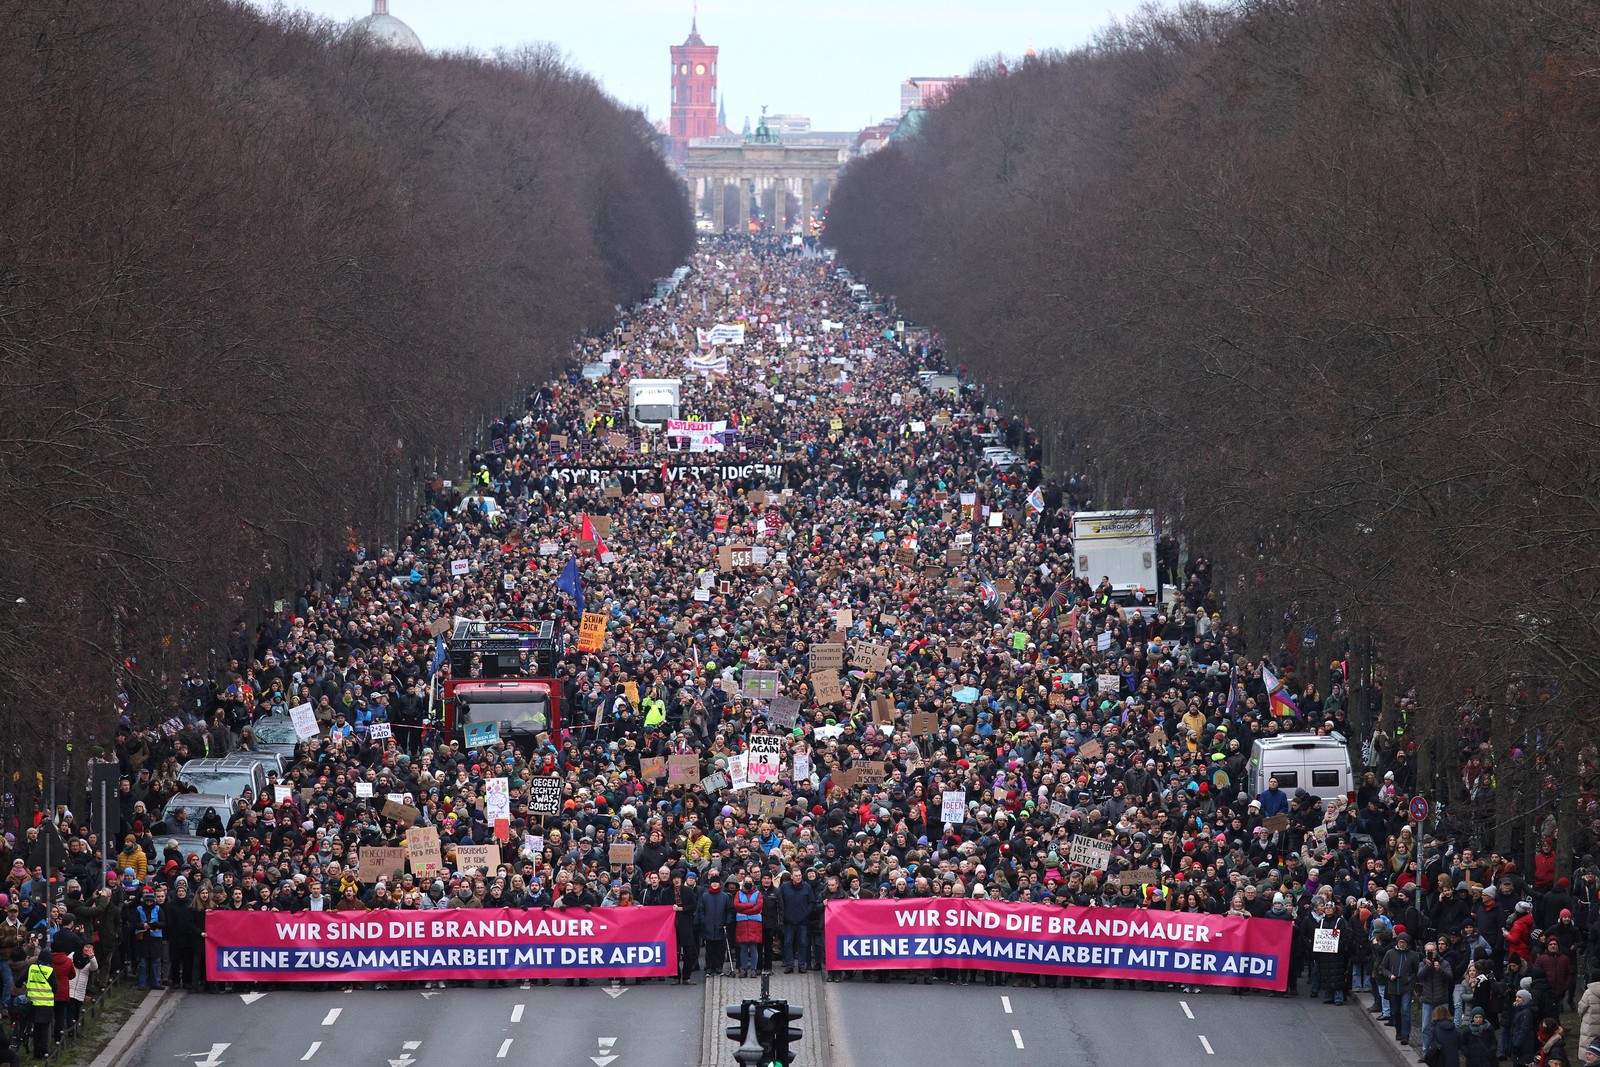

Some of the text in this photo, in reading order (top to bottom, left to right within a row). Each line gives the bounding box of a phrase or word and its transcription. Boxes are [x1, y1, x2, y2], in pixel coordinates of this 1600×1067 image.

[668, 420, 714, 430] ASYLRECHT
[732, 551, 750, 560] FCK
[858, 644, 878, 656] FCK
[854, 654, 872, 665] AFD
[820, 686, 840, 697] MERZ
[751, 736, 779, 746] NEVER
[750, 744, 779, 754] AGAIN
[760, 754, 768, 764] IS
[750, 762, 778, 776] NOW
[532, 778, 559, 787] GEGEN
[530, 787, 560, 798] RECHTS!
[944, 802, 964, 810] IDEEN
[944, 813, 962, 822] MERZ
[1074, 836, 1112, 852] NIE WIEDER
[425, 848, 440, 856] RAUS
[458, 846, 488, 854] FASCHISMUS
[1073, 846, 1088, 854] IST
[276, 922, 321, 940] WIR
[327, 922, 383, 939] SIND
[390, 922, 425, 938] DIE
[432, 918, 594, 938] BRANDMAUER
[895, 910, 940, 928] WIR
[945, 908, 1001, 929] SIND
[1006, 914, 1042, 932] DIE
[1048, 916, 1210, 942] BRANDMAUER
[223, 946, 661, 968] KEINE ZUSAMMENARBEIT MIT DER AFD!
[843, 938, 1274, 976] KEINE ZUSAMMENARBEIT MIT DER AFD!
